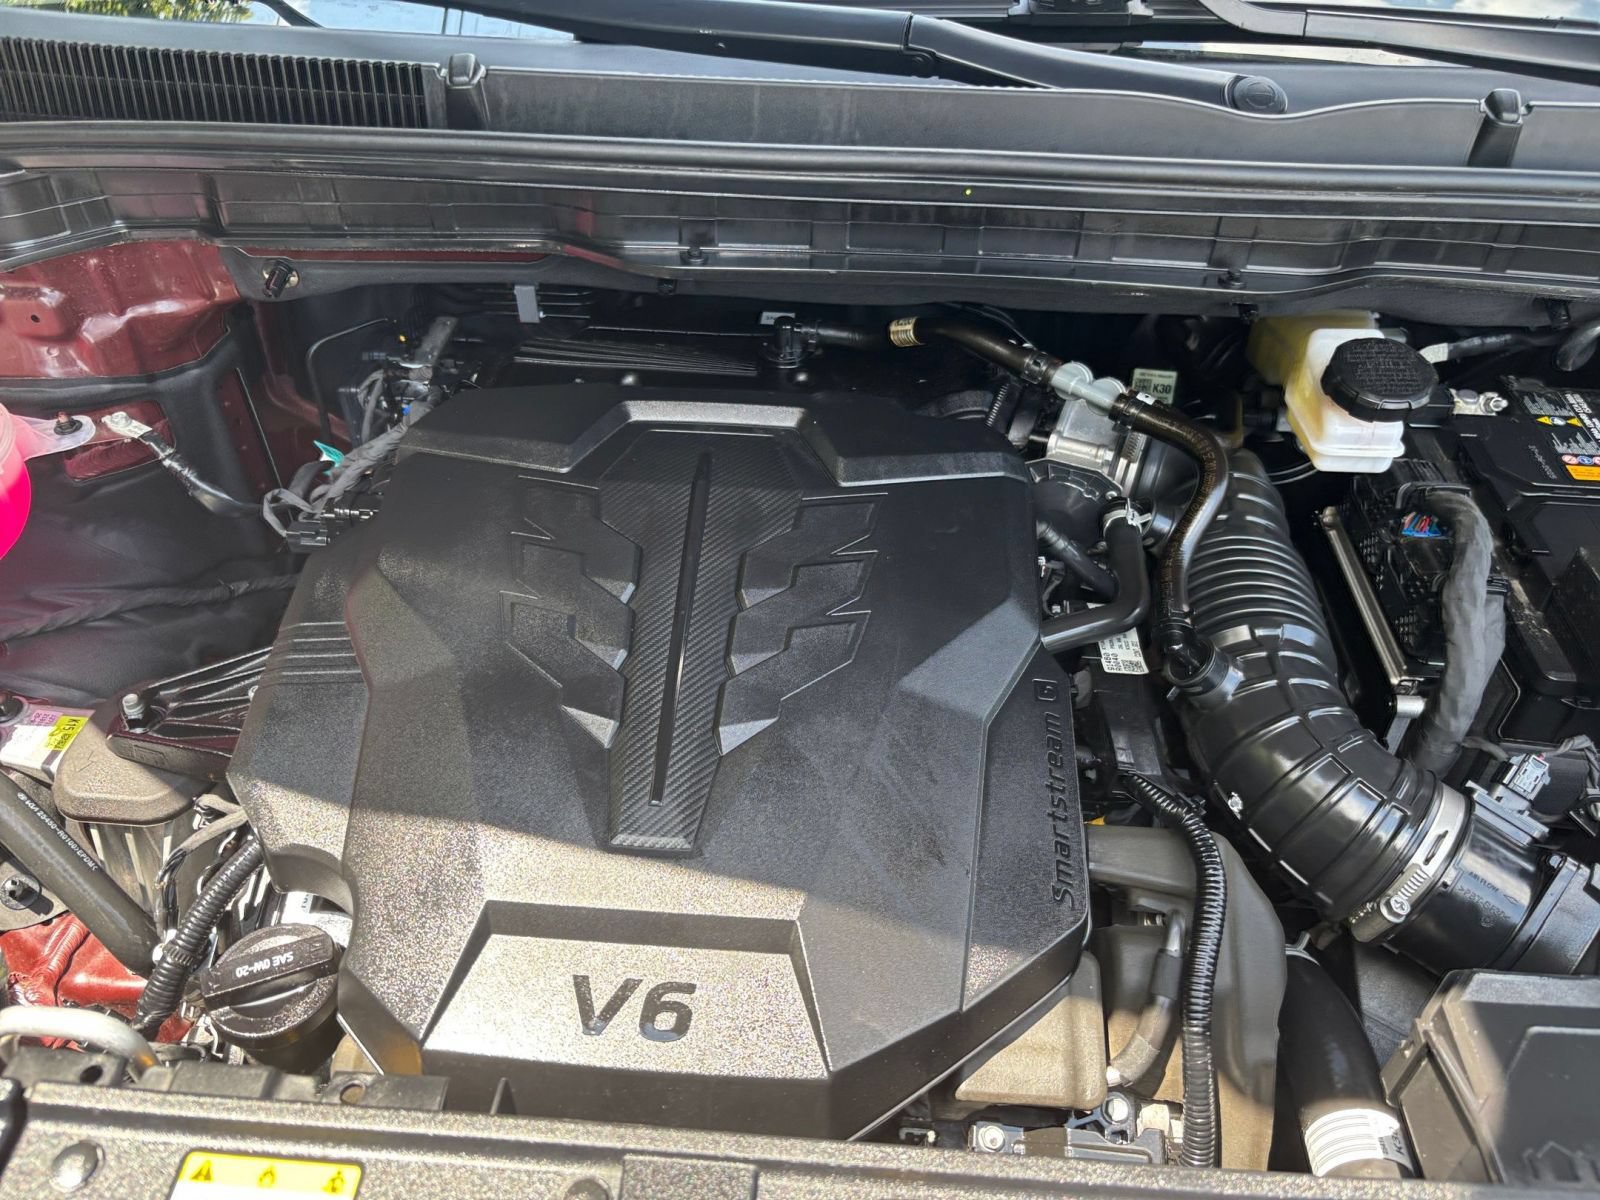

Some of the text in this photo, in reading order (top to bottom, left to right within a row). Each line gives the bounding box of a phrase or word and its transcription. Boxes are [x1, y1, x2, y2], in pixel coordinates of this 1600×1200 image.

[1152, 383, 1172, 395] K30
[1044, 710, 1074, 909] Smartstream
[235, 951, 295, 978] SAE 0W-20
[572, 974, 697, 1042] V6
